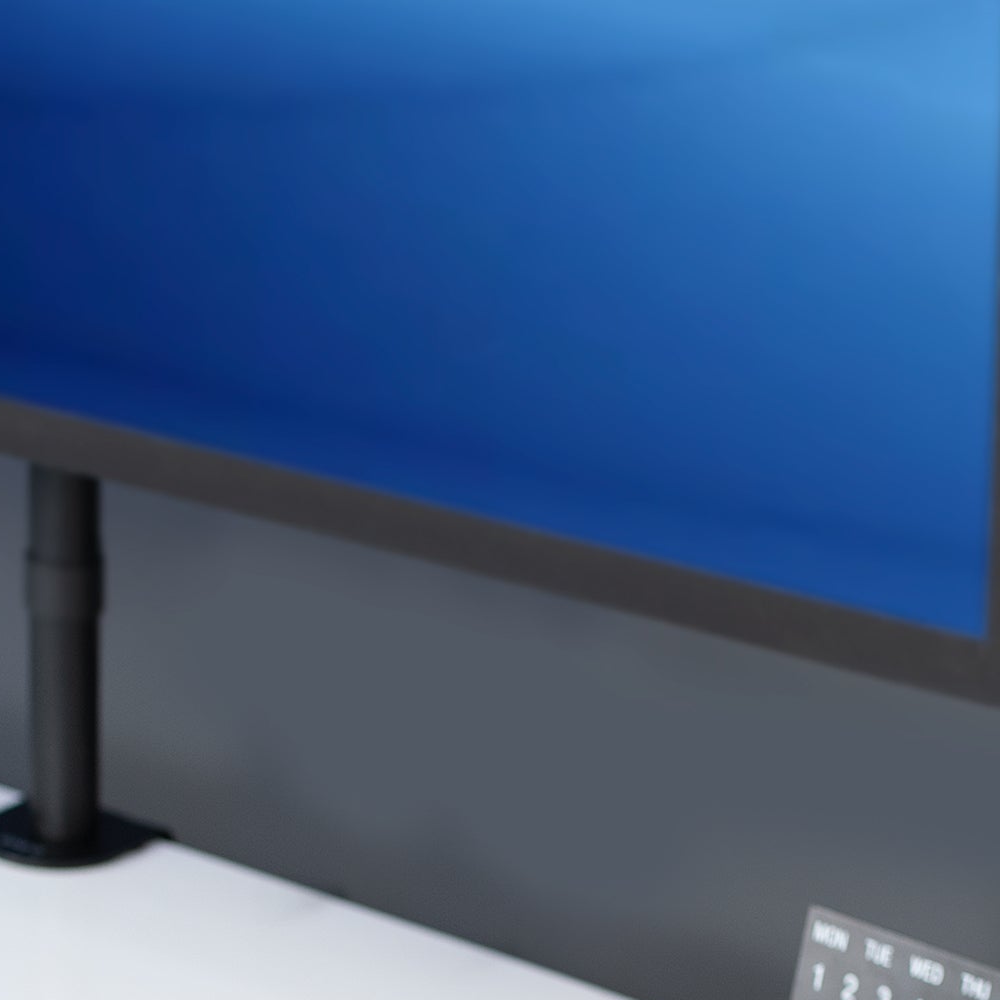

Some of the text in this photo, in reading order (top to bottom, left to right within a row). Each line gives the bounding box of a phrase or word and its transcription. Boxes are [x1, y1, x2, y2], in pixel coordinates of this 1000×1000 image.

[811, 919, 850, 952] MON
[864, 937, 894, 968] TUE
[909, 954, 945, 986] WED
[812, 961, 826, 993] 1
